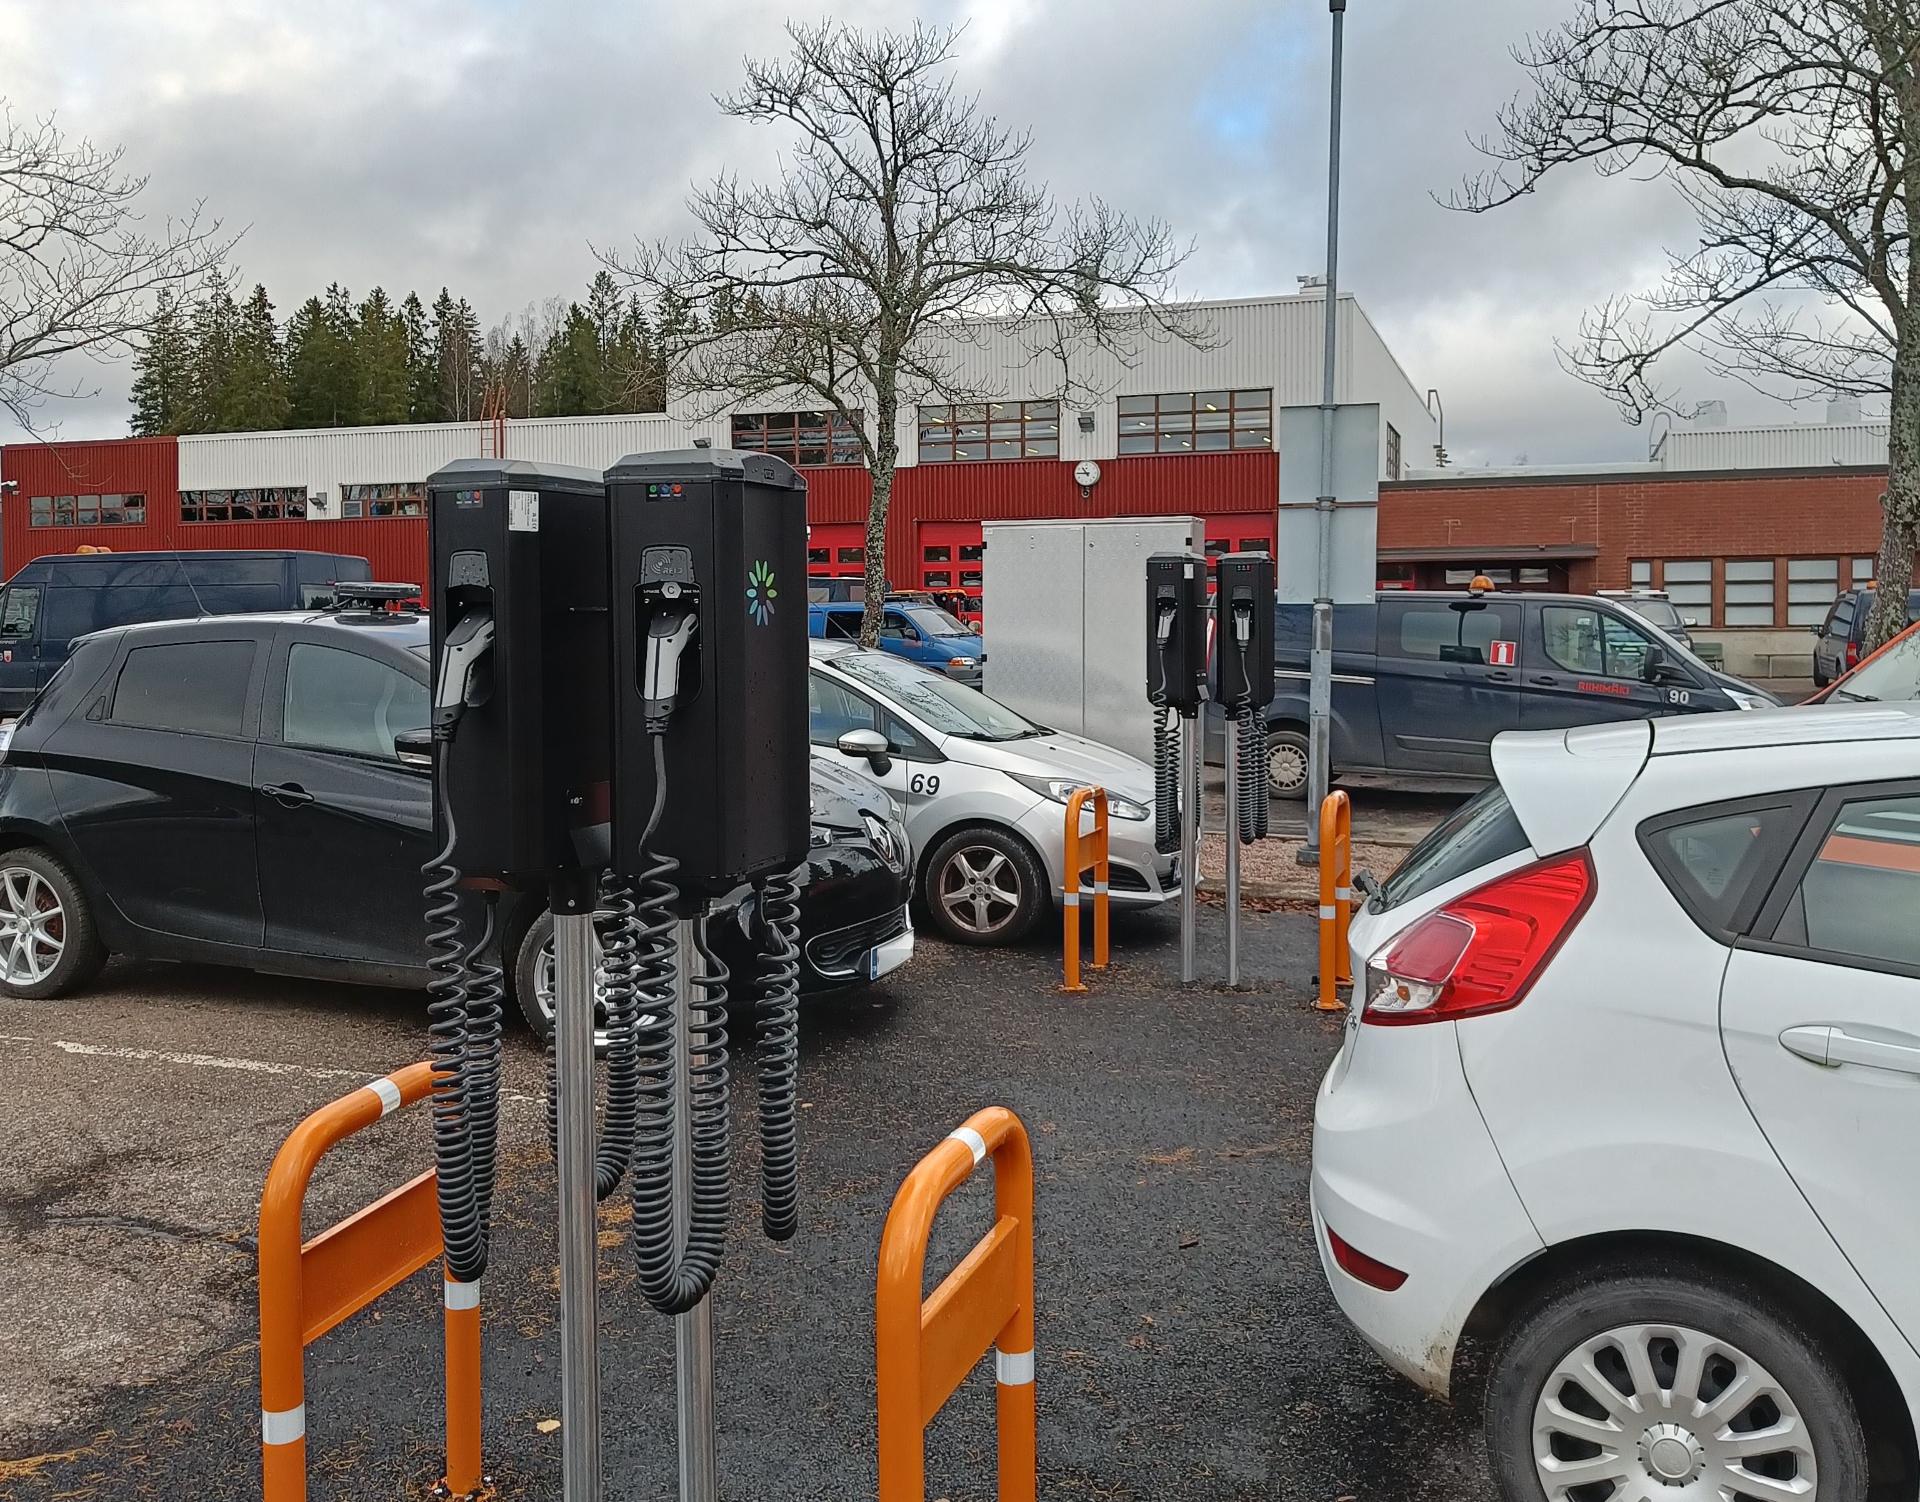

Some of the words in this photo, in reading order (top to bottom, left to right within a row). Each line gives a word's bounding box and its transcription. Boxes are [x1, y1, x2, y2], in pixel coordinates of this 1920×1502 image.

[1577, 681, 1631, 697] RIIHIMÄKI
[1668, 690, 1690, 704] 90
[910, 773, 940, 796] 69
